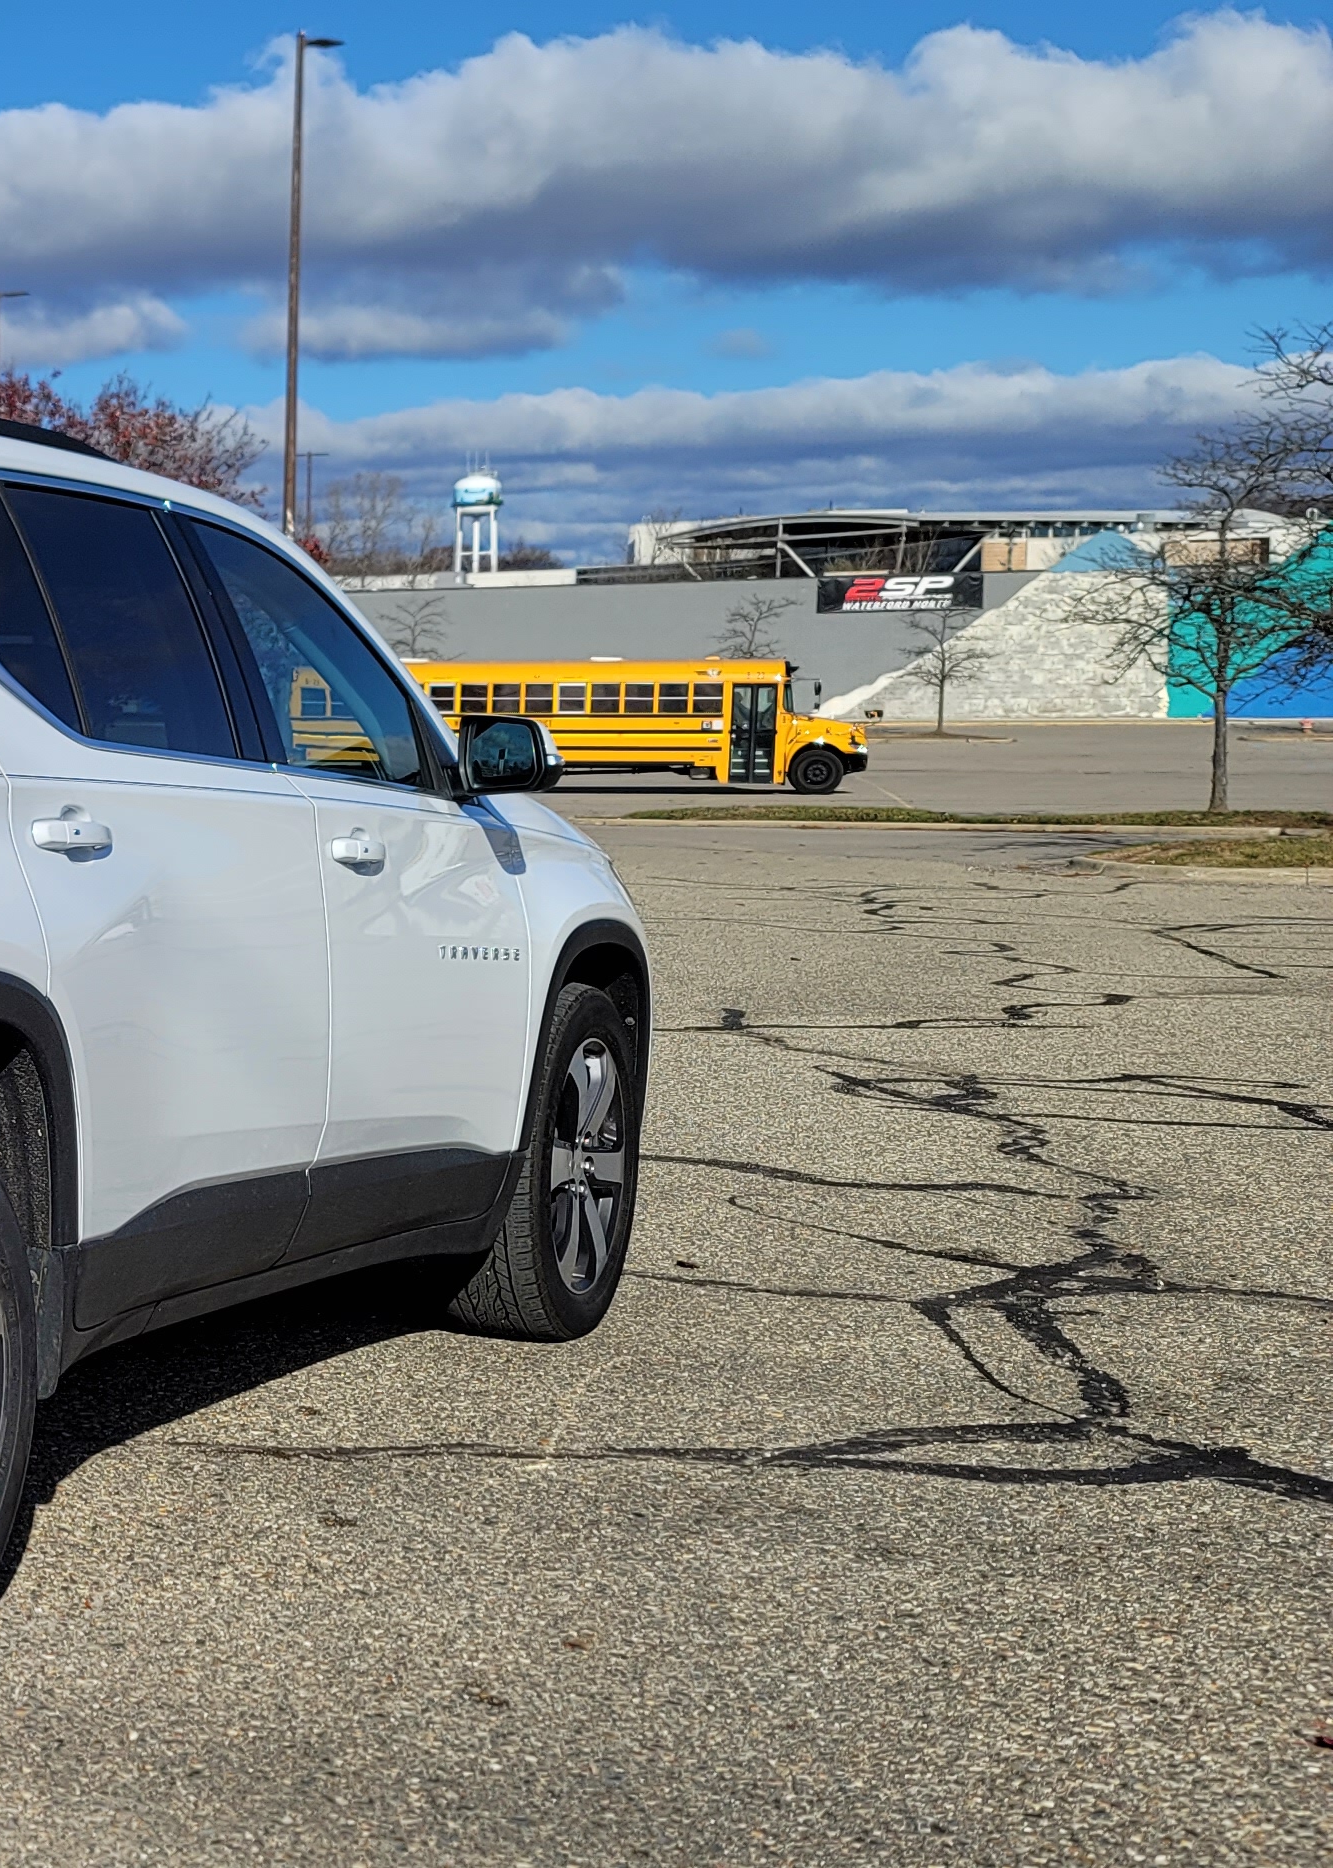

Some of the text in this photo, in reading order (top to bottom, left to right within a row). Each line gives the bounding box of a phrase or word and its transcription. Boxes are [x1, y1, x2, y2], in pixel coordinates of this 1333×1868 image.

[845, 576, 954, 598] 2SP
[842, 600, 910, 611] WATERFORD
[438, 944, 521, 962] TRAVERSE
